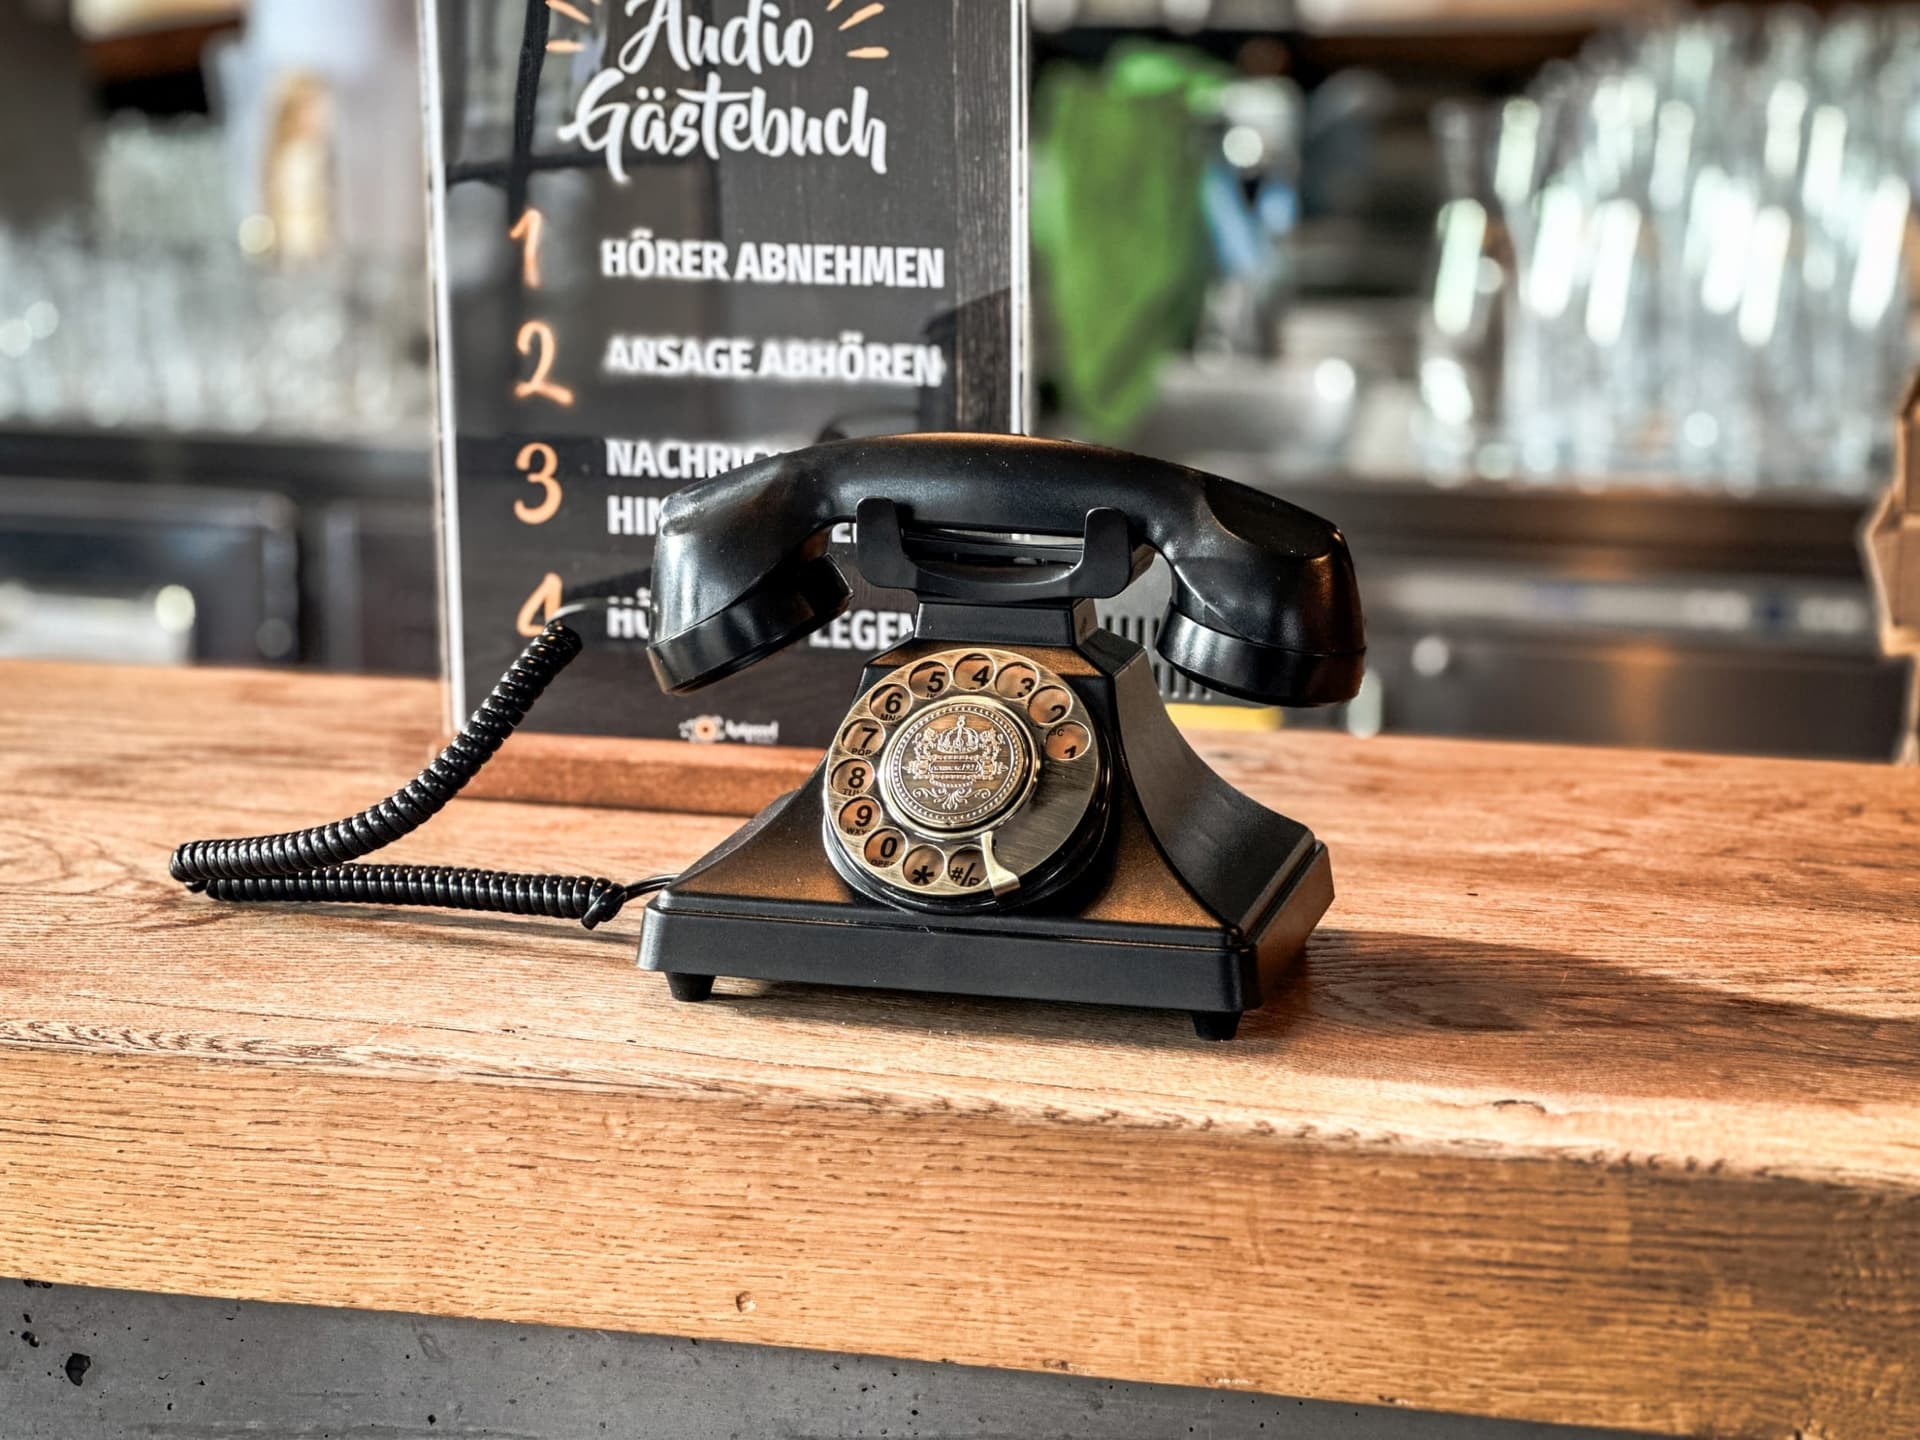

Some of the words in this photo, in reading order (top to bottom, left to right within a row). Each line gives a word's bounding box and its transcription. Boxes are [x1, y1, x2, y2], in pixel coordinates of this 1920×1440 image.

[618, 0, 813, 74] Audio
[557, 68, 888, 185] Gästebuch
[510, 208, 543, 288] 1
[601, 228, 731, 280] HÖRER
[733, 242, 945, 288] ABNEHMEN
[514, 320, 574, 404] 2
[606, 335, 755, 378] ANSAGE
[757, 330, 946, 387] ABHÖREN
[513, 442, 563, 524] 3
[516, 571, 562, 637] 4
[885, 692, 903, 714] 6
[927, 671, 946, 693] 5
[862, 727, 879, 748] 7
[847, 766, 866, 788] 8
[854, 804, 873, 827] 9
